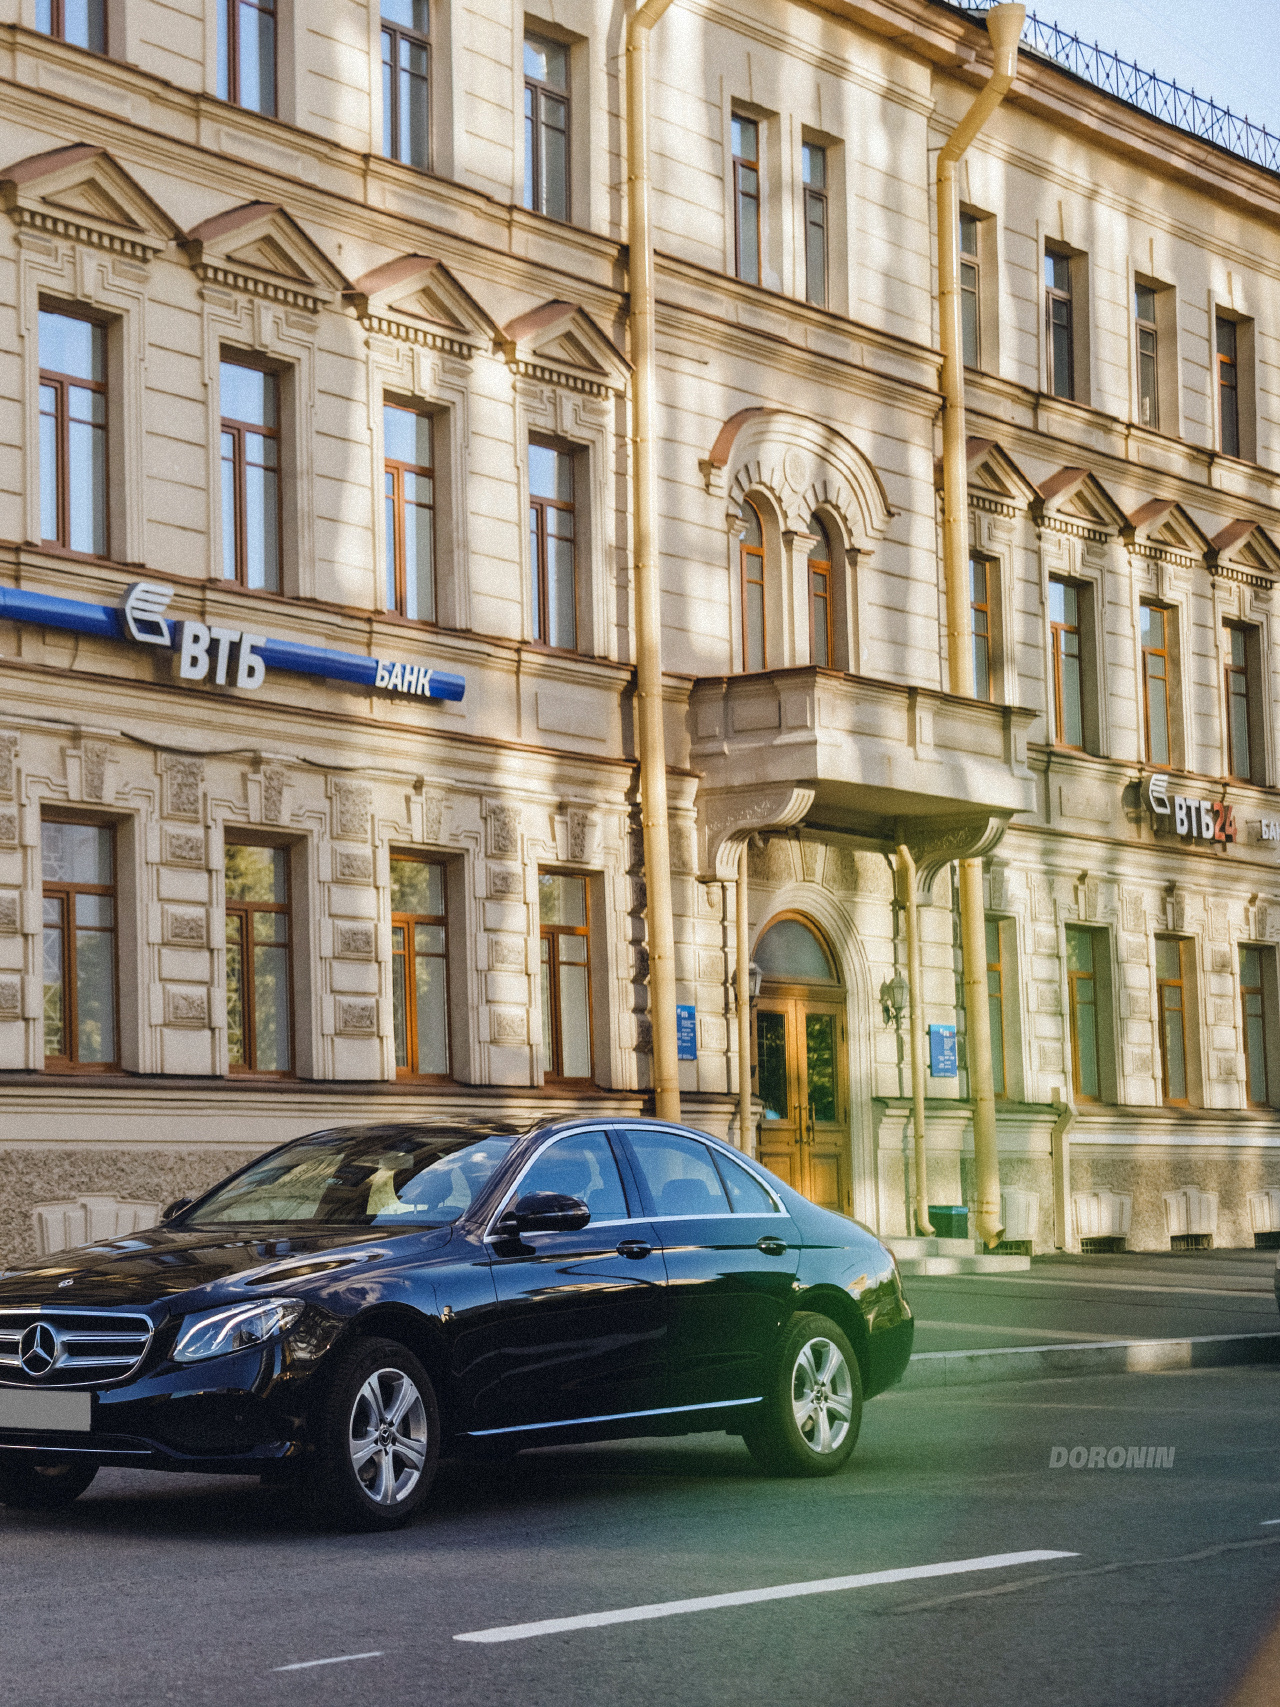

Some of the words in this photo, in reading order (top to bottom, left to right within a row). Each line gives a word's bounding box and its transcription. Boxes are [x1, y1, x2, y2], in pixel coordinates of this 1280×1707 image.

[180, 621, 266, 689] ВТБ
[376, 660, 431, 696] БАНК
[1175, 795, 1237, 842] ВТБ24
